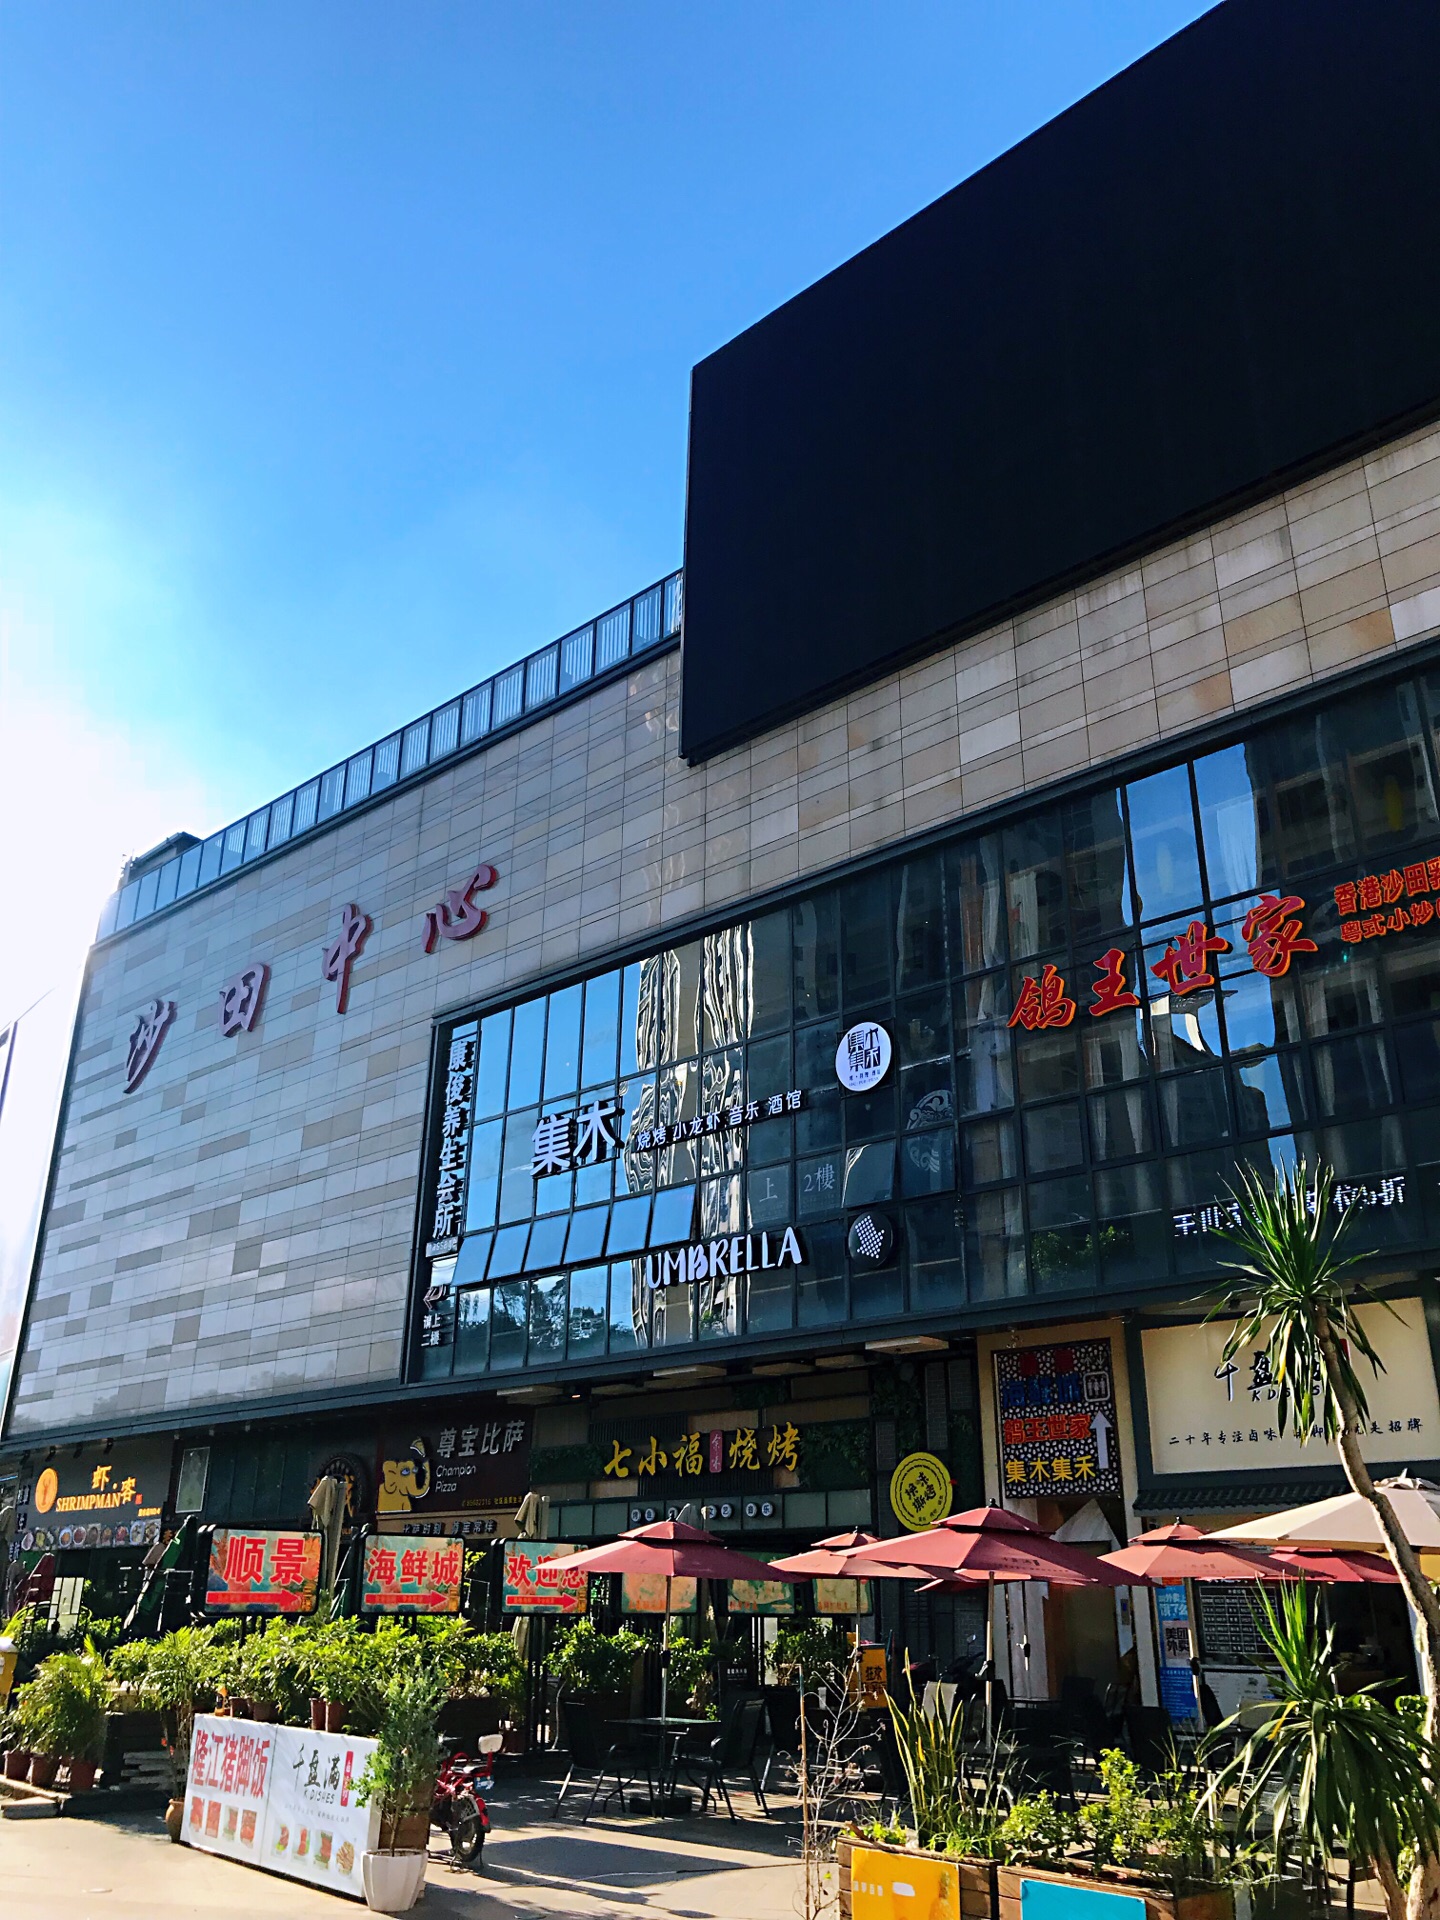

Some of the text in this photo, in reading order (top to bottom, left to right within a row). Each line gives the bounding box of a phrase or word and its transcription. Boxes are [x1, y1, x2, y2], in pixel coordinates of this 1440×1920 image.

[1341, 897, 1440, 943] 粤式小炒
[124, 863, 498, 1094] 沙田中心
[1007, 894, 1318, 1031] 鸽王世家
[431, 1040, 467, 1239] 康俊养生会所
[529, 1100, 617, 1176] 集木
[636, 1089, 802, 1151] 烧烤 小龙虾 音乐 酒馆
[759, 1178, 778, 1203] 上
[646, 1226, 802, 1289] UMBRELLA
[437, 1420, 525, 1459] 尊宝比萨
[729, 1421, 801, 1472] 烧烤
[1003, 1413, 1093, 1445] 鸽王世家
[603, 1432, 704, 1478] 七小福
[1005, 1455, 1096, 1483] 集木集禾
[56, 1492, 121, 1512] SHRIMPMAN
[223, 1534, 308, 1585] 顺景
[366, 1548, 460, 1587] 海鲜城
[191, 1729, 271, 1799] 隆江猪脚饭
